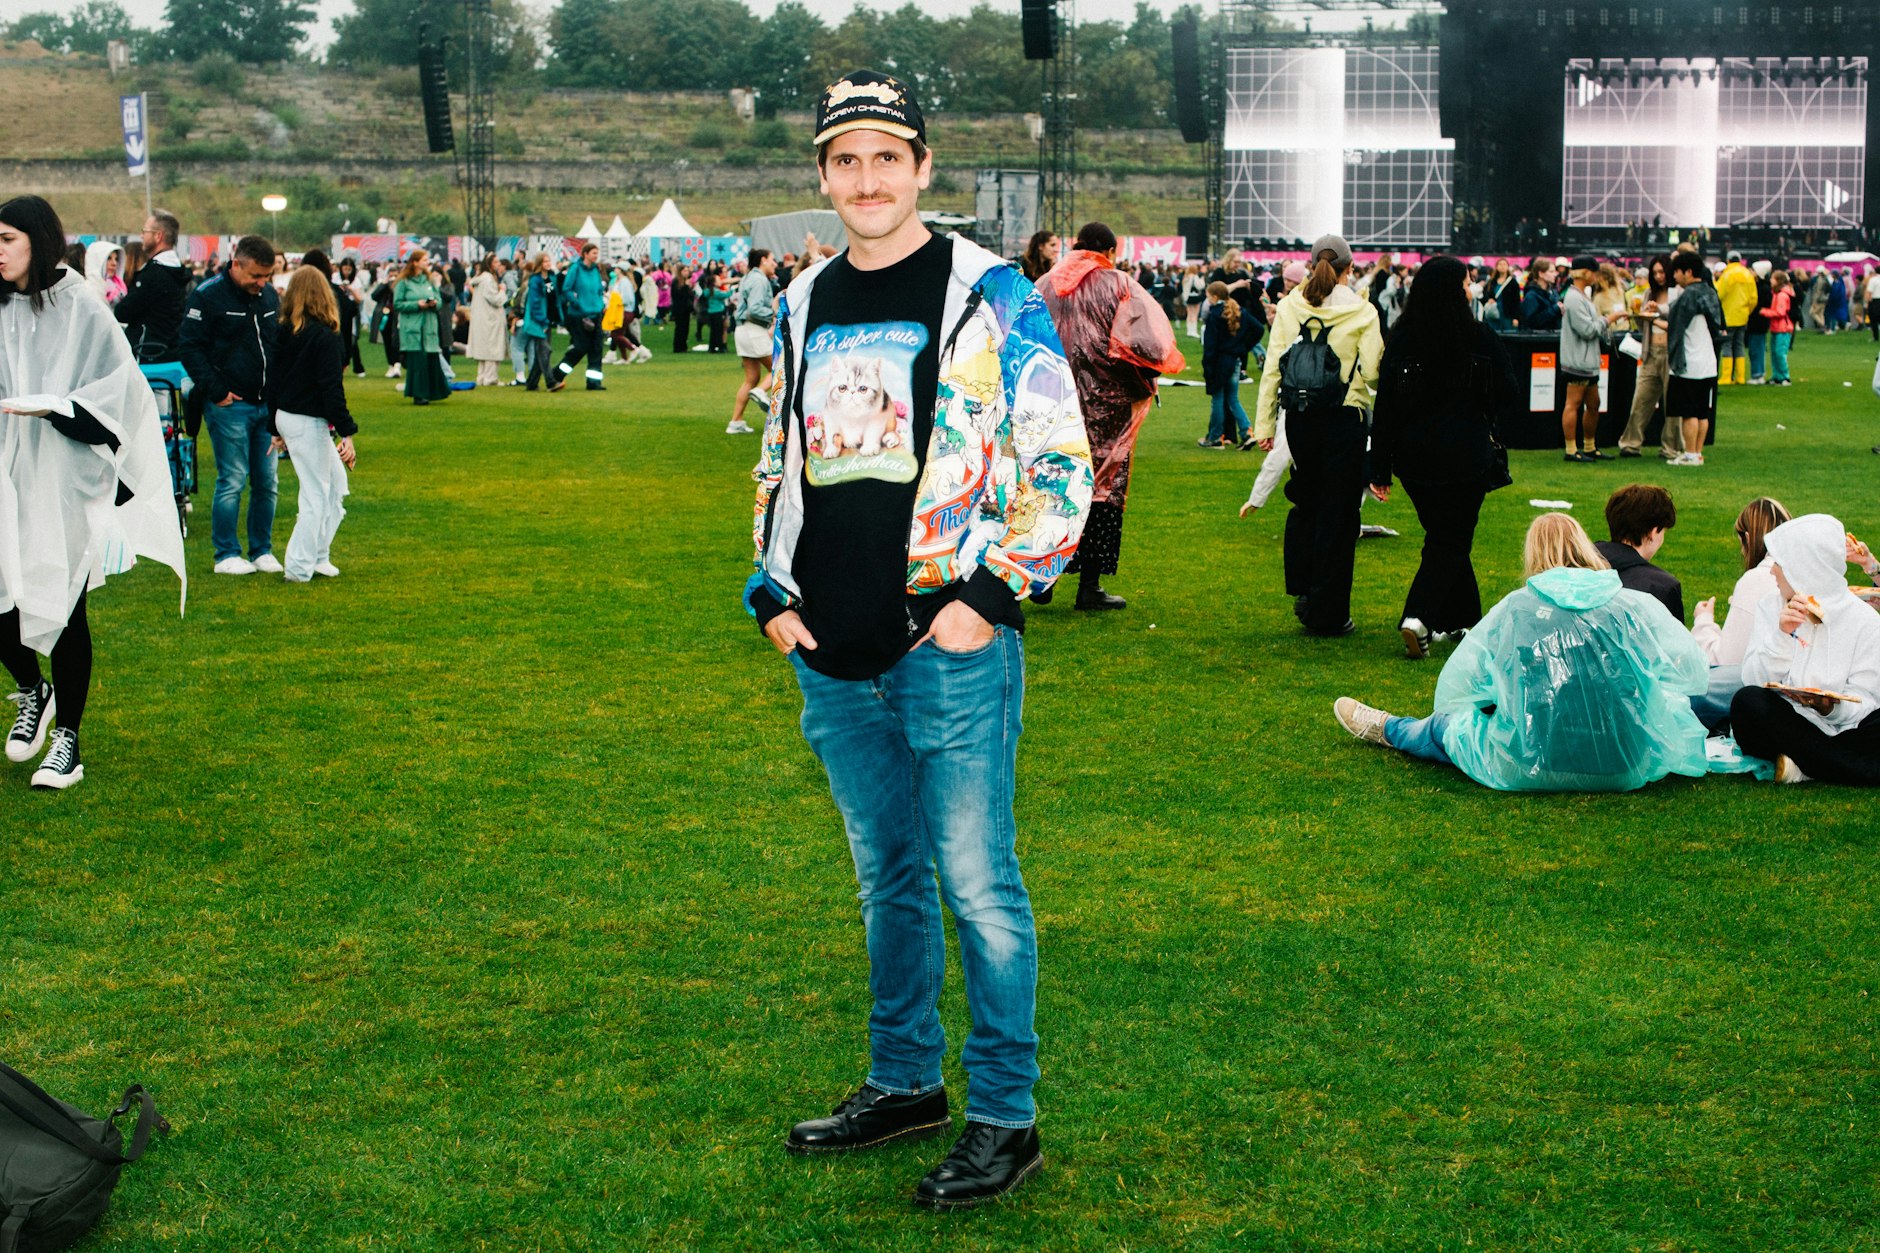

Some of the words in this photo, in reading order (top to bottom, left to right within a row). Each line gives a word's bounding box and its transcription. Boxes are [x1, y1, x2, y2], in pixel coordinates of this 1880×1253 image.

[822, 106, 857, 126] ANDREW
[806, 330, 838, 352] It's
[838, 330, 883, 358] super
[885, 330, 919, 346] cute
